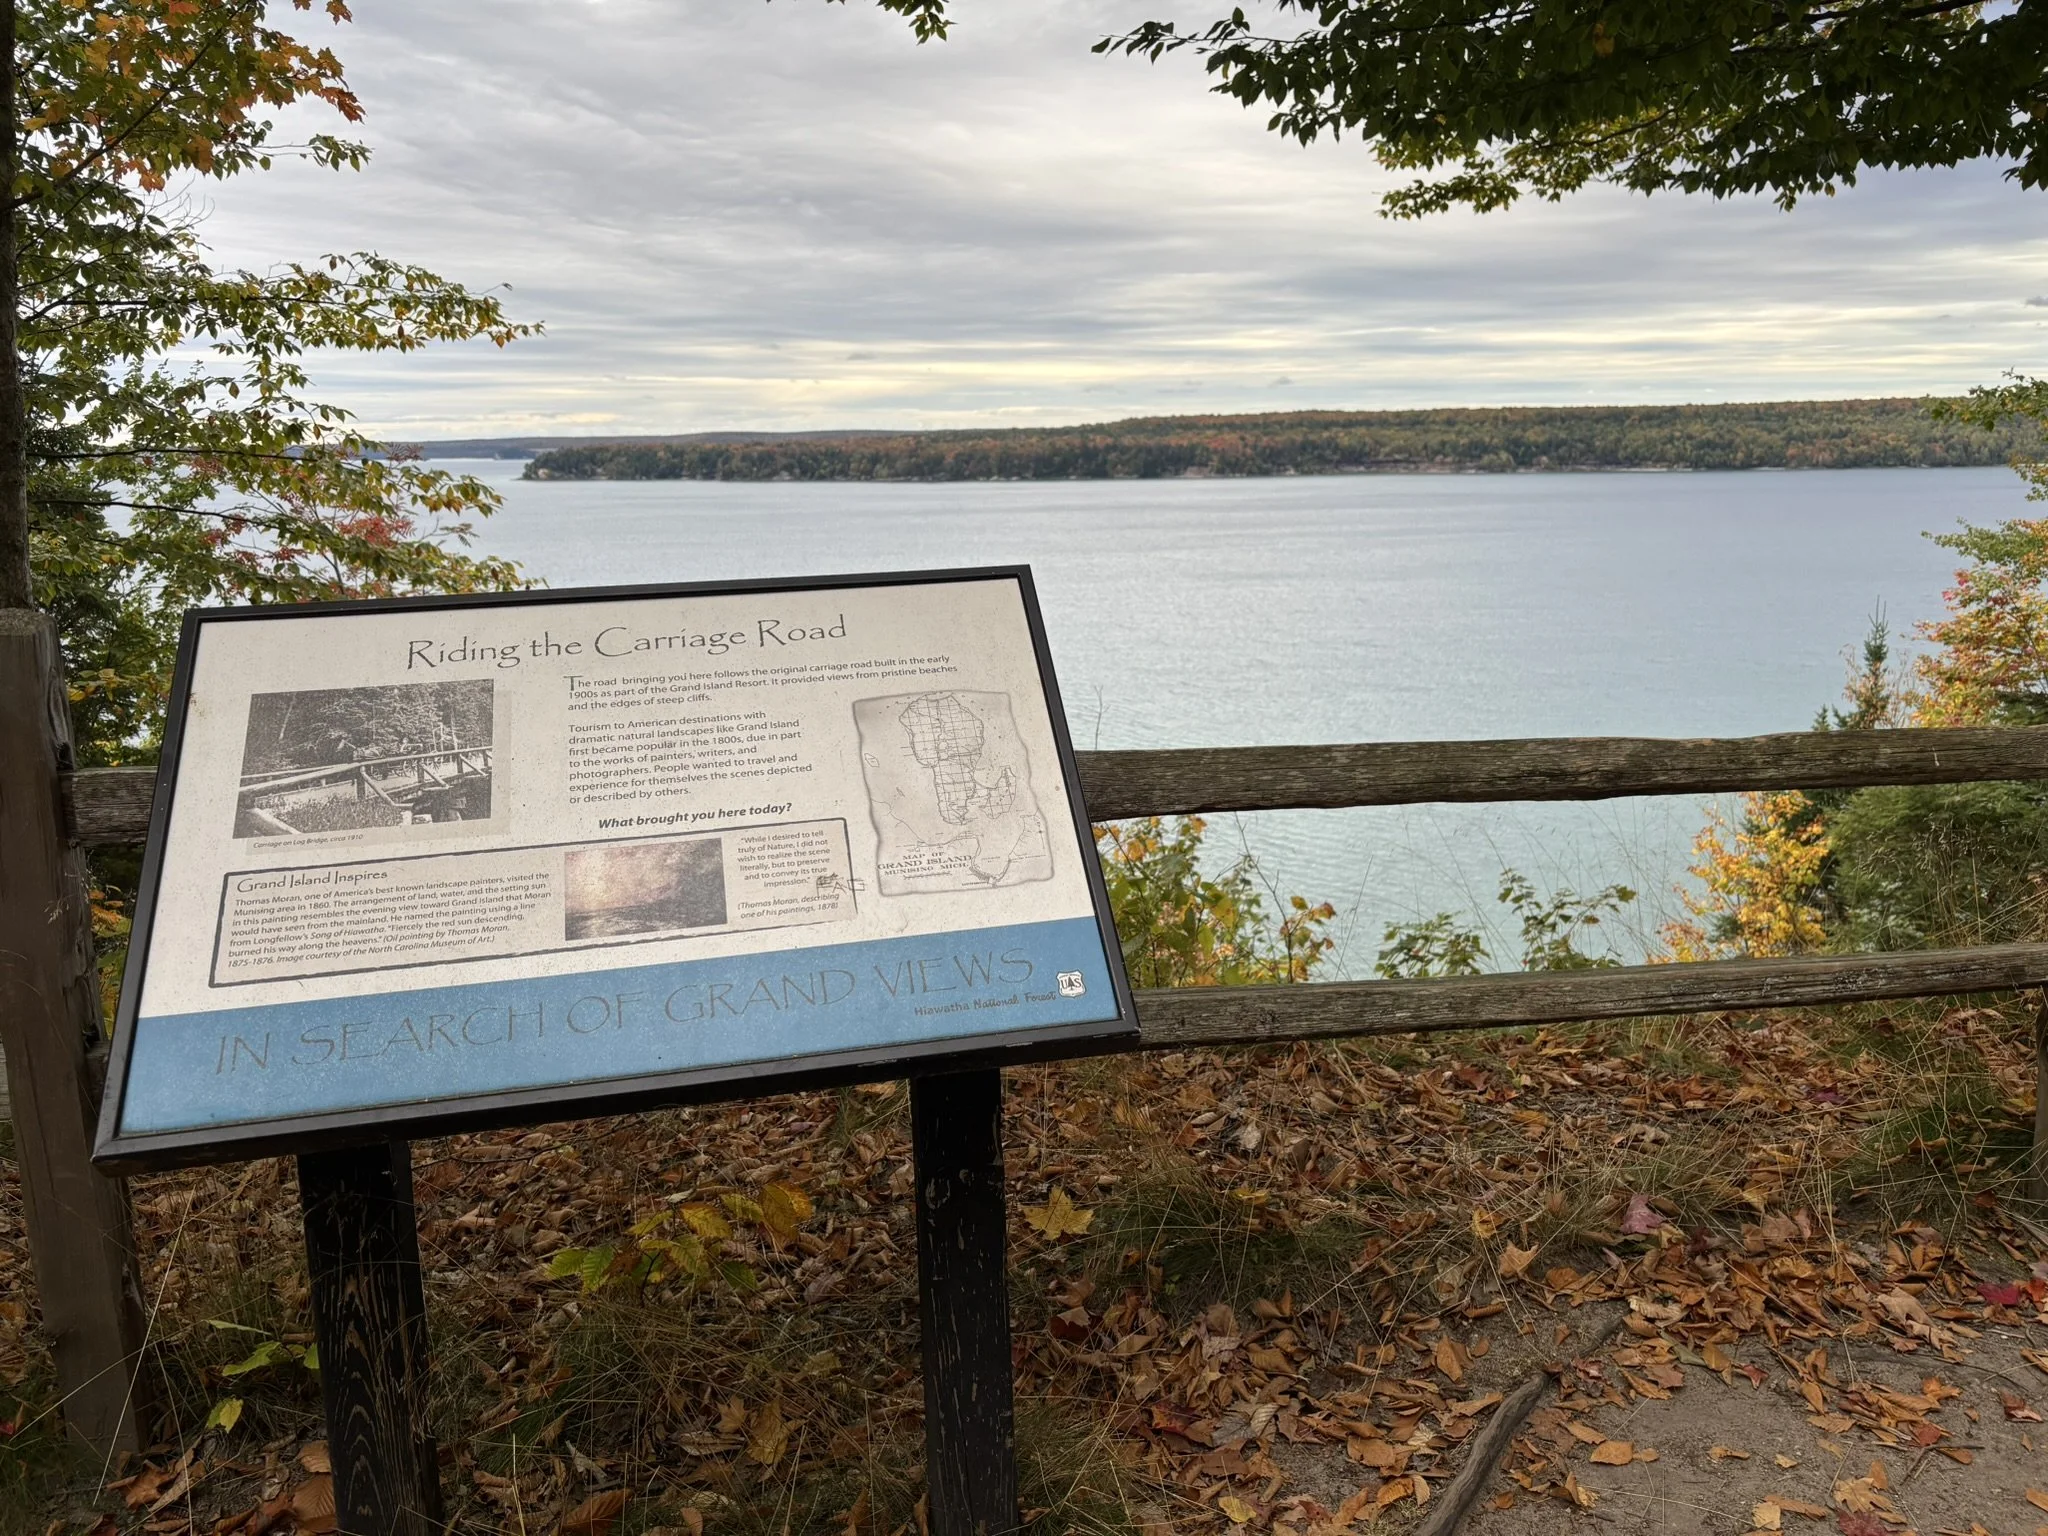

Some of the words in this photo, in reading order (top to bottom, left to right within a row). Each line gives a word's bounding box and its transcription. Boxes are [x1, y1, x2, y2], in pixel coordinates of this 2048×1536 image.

[407, 635, 520, 669] Riding
[530, 631, 583, 657] the
[594, 627, 747, 657] Carriage
[756, 614, 847, 647] Road
[564, 675, 591, 691] The
[594, 677, 617, 686] road
[622, 675, 666, 685] bringing
[668, 674, 687, 683] you
[714, 670, 750, 678] follows
[770, 665, 808, 675] original
[809, 663, 849, 672] carriage
[850, 660, 873, 669] road
[874, 659, 897, 667] built
[909, 657, 926, 665] the
[926, 656, 951, 664] early
[569, 690, 598, 699] 1900s
[614, 688, 635, 698] part
[669, 683, 701, 692] Grand
[703, 680, 733, 690] Island
[735, 679, 770, 687] Resort.
[780, 674, 825, 686] provided
[826, 673, 855, 681] views
[855, 671, 880, 679] from
[881, 668, 918, 679] pristine
[918, 665, 958, 674] beaches
[568, 702, 588, 711] and
[590, 701, 608, 709] the
[610, 699, 642, 709] edges
[643, 697, 655, 705] of
[656, 697, 685, 705] steep
[687, 693, 713, 702] cliffs.
[568, 722, 613, 733] Tourism
[627, 718, 677, 728] American
[679, 713, 742, 724] destinations
[743, 710, 767, 720] with
[568, 733, 615, 744] dramatic
[618, 730, 655, 740] natural
[657, 727, 714, 737] landscapes
[716, 724, 735, 733] like
[736, 721, 768, 731] Grand
[769, 719, 800, 729] Island
[569, 747, 589, 756] first
[591, 745, 634, 754] became
[636, 740, 677, 753] popular
[679, 739, 690, 747] in
[692, 738, 710, 746] the
[713, 735, 745, 745] 1800s,
[746, 734, 766, 742] due
[768, 732, 778, 740] in
[780, 731, 802, 742] part
[569, 760, 581, 768] to
[583, 757, 601, 767] the
[603, 755, 635, 765] works
[637, 753, 648, 762] of
[650, 752, 696, 764] painters,
[697, 748, 736, 758] writers,
[737, 745, 758, 754] and
[569, 766, 652, 782] photographers.
[654, 762, 691, 774] People
[692, 758, 732, 770] wanted
[747, 755, 776, 765] travel
[778, 753, 798, 763] and
[569, 781, 629, 794] experience
[631, 778, 646, 787] for
[648, 773, 709, 785] themselves
[710, 771, 728, 780] the
[730, 770, 765, 778] scenes
[766, 763, 813, 777] depicted
[583, 790, 637, 802] described
[639, 789, 653, 800] by
[654, 787, 692, 797] others.
[599, 817, 635, 829] What
[636, 812, 690, 825] brought
[691, 811, 716, 823] you
[717, 808, 747, 818] here
[749, 802, 793, 816] today?
[771, 832, 801, 840] desired
[796, 858, 831, 868] preserve
[877, 860, 923, 870] GRAND
[927, 855, 973, 865] ISLAND
[884, 866, 934, 876] MUNISING
[237, 875, 287, 892] Grand
[289, 871, 331, 887] Island
[334, 868, 388, 885] Inspires
[744, 872, 760, 880] and
[235, 898, 271, 906] Thomas
[323, 891, 332, 899] of
[375, 886, 394, 894] best
[426, 881, 468, 890] landscape
[507, 873, 534, 882] visited
[536, 872, 550, 880] the
[801, 894, 841, 903] describing
[276, 955, 304, 963] Image
[305, 951, 342, 960] courtesy
[343, 948, 352, 956] of
[353, 947, 367, 955] the
[368, 944, 393, 954] North
[394, 942, 430, 951] Carolina
[430, 939, 466, 948] Museum
[467, 936, 477, 944] of
[216, 1031, 270, 1075] IN
[292, 1006, 545, 1066] SEARCH
[566, 991, 644, 1033] OF
[665, 969, 856, 1023] GRAND
[873, 948, 1033, 997] VIEWS
[914, 1001, 970, 1016] Hiawatha
[974, 994, 1020, 1010] National
[1024, 991, 1056, 1003] Forest
